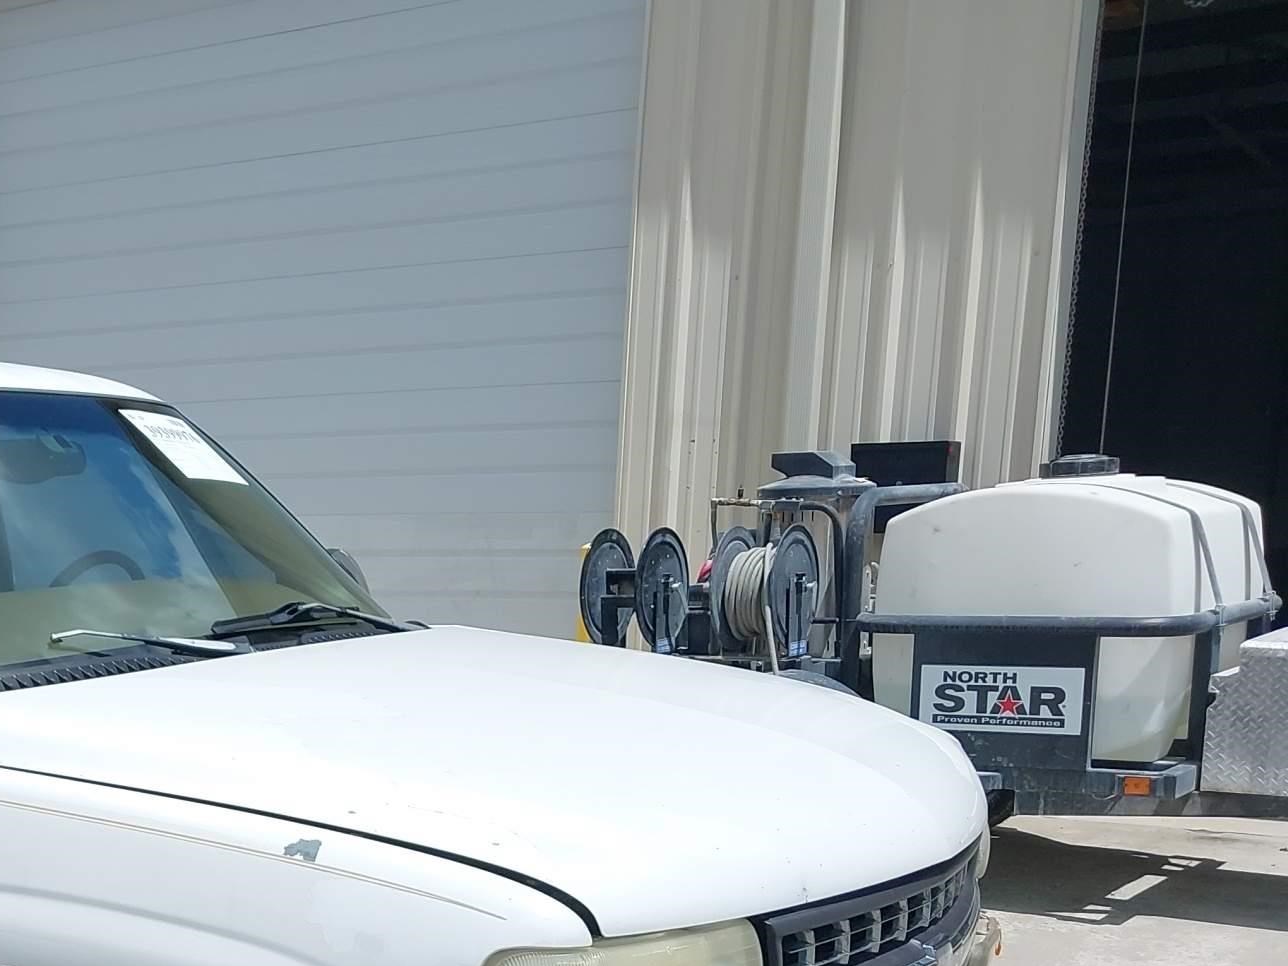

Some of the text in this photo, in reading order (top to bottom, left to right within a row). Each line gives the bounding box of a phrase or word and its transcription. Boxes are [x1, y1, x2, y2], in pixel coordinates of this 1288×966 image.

[942, 670, 1018, 684] NORTH
[932, 683, 1066, 717] STAR
[936, 715, 1061, 727] Proven Performance
